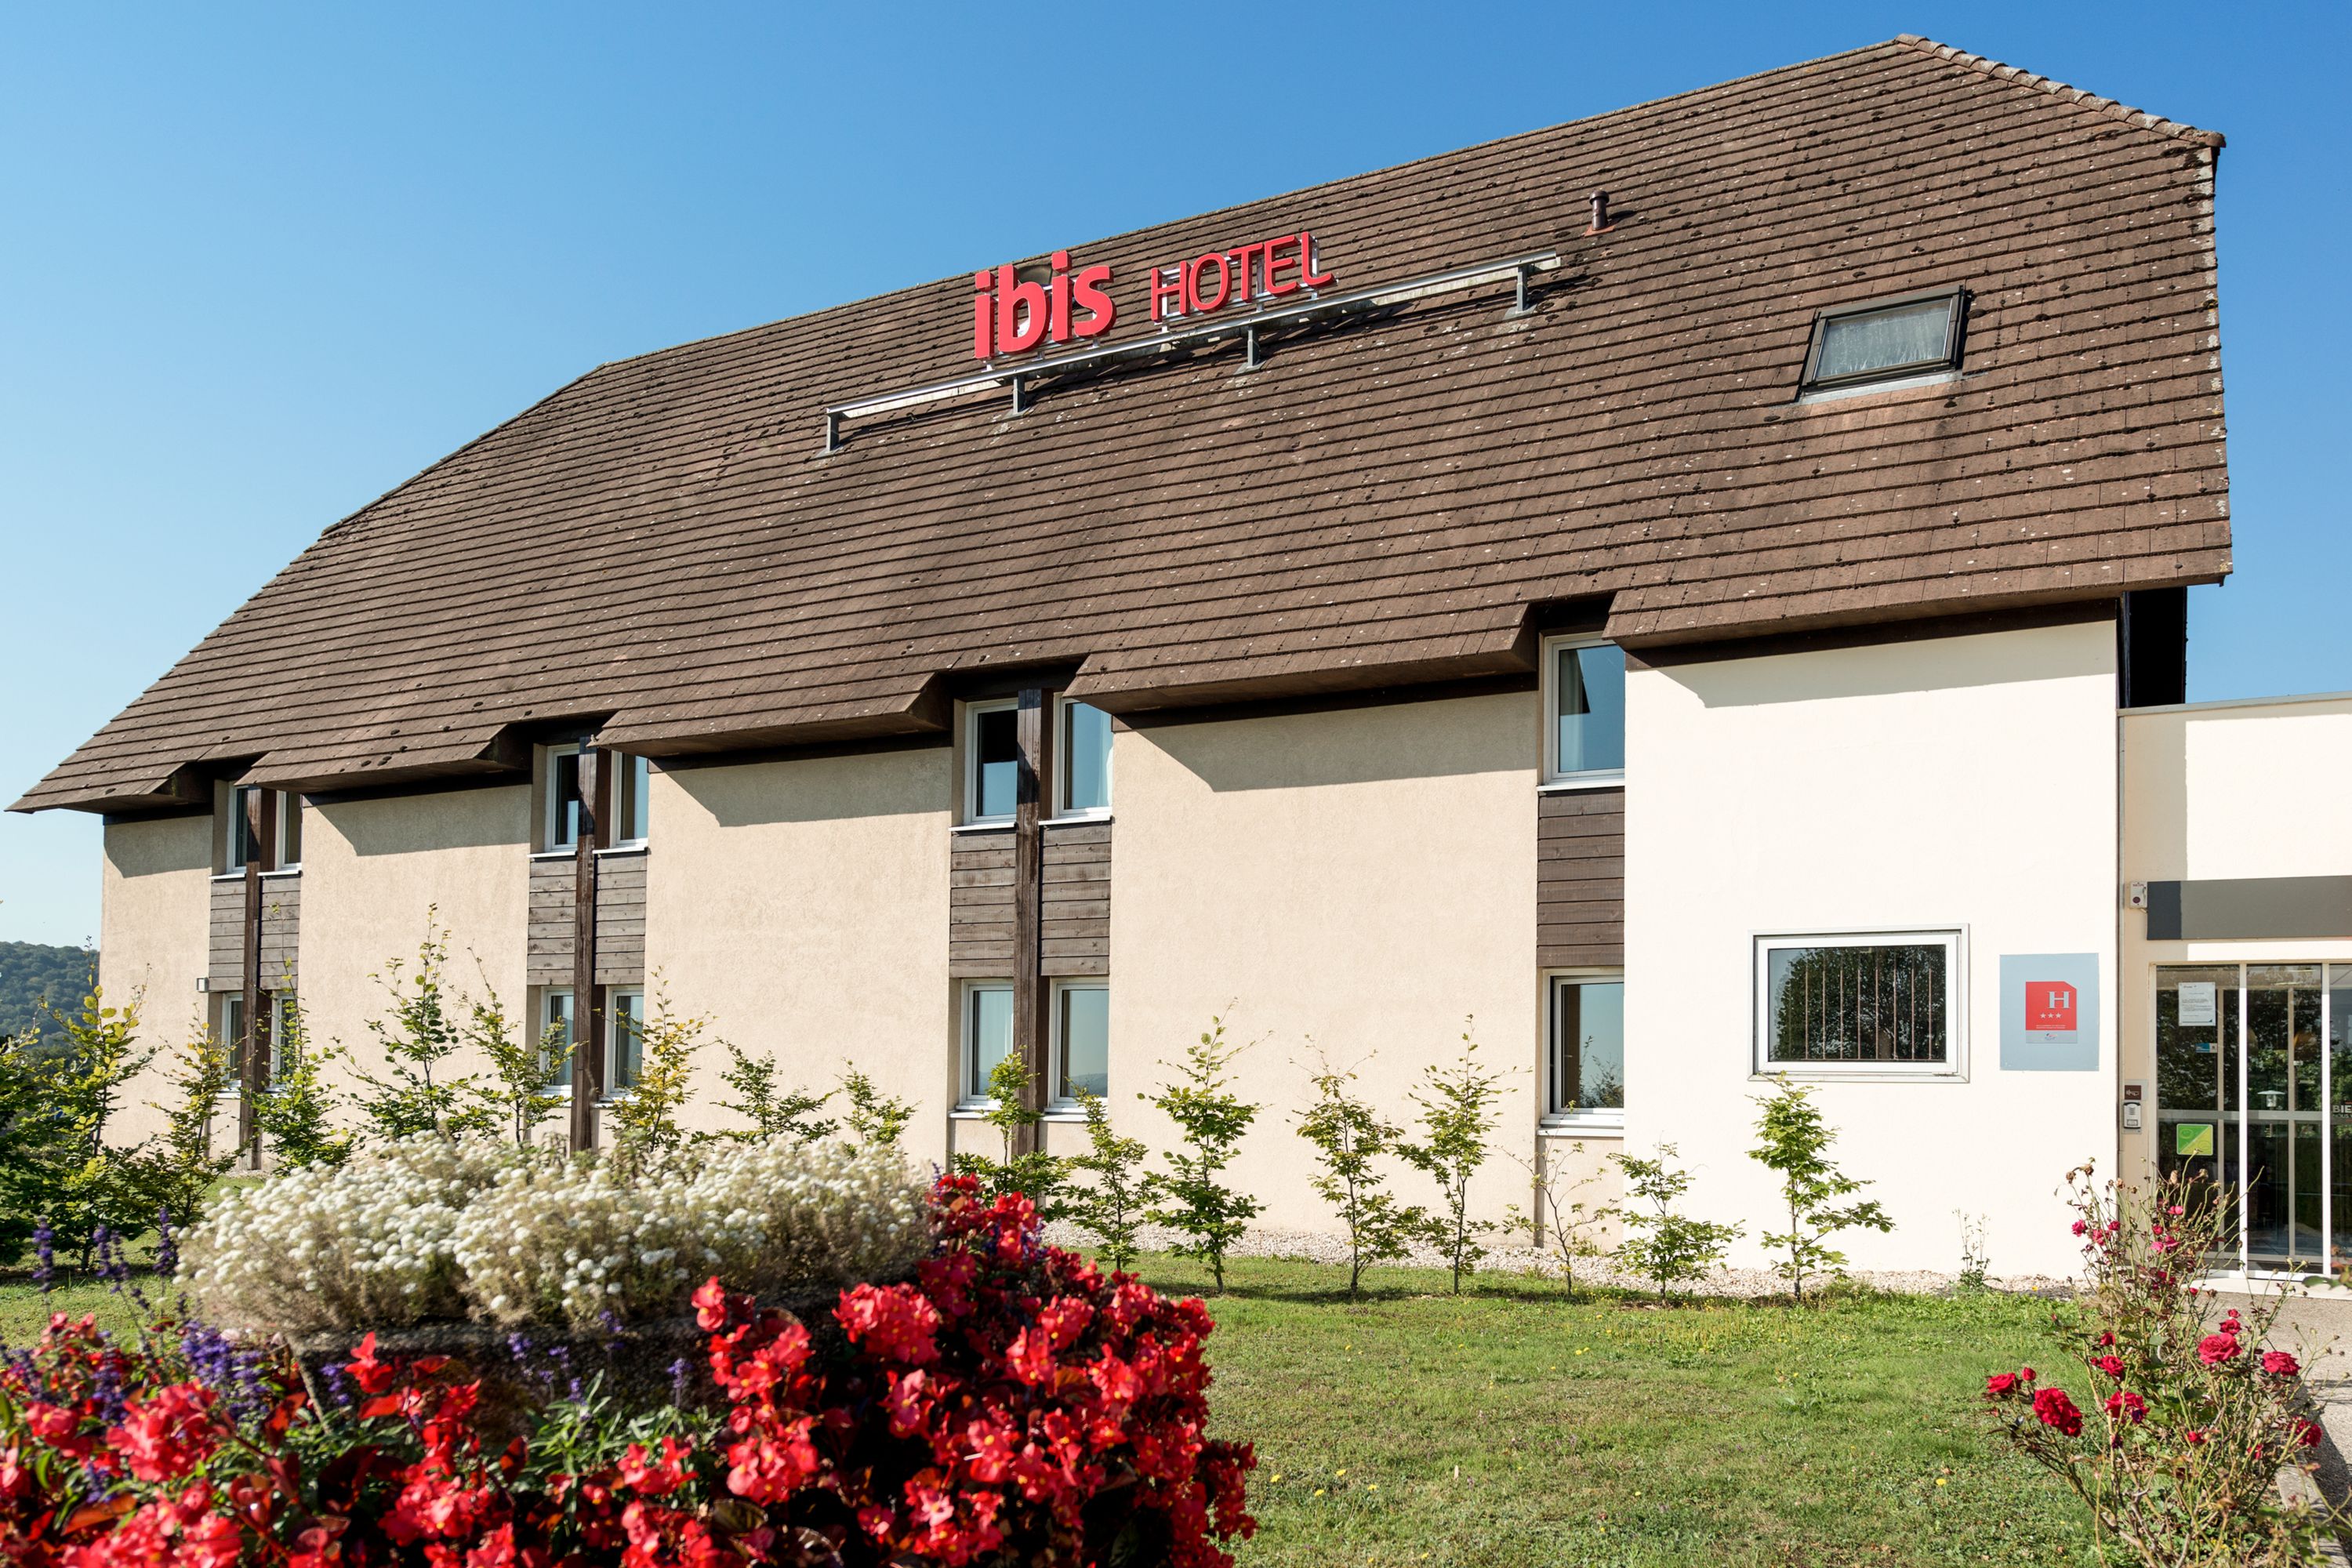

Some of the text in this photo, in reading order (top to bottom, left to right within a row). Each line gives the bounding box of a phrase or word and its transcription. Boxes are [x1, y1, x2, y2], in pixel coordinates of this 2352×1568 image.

[975, 231, 1334, 359] ibis HOTEL
[2048, 991, 2070, 1009] H
